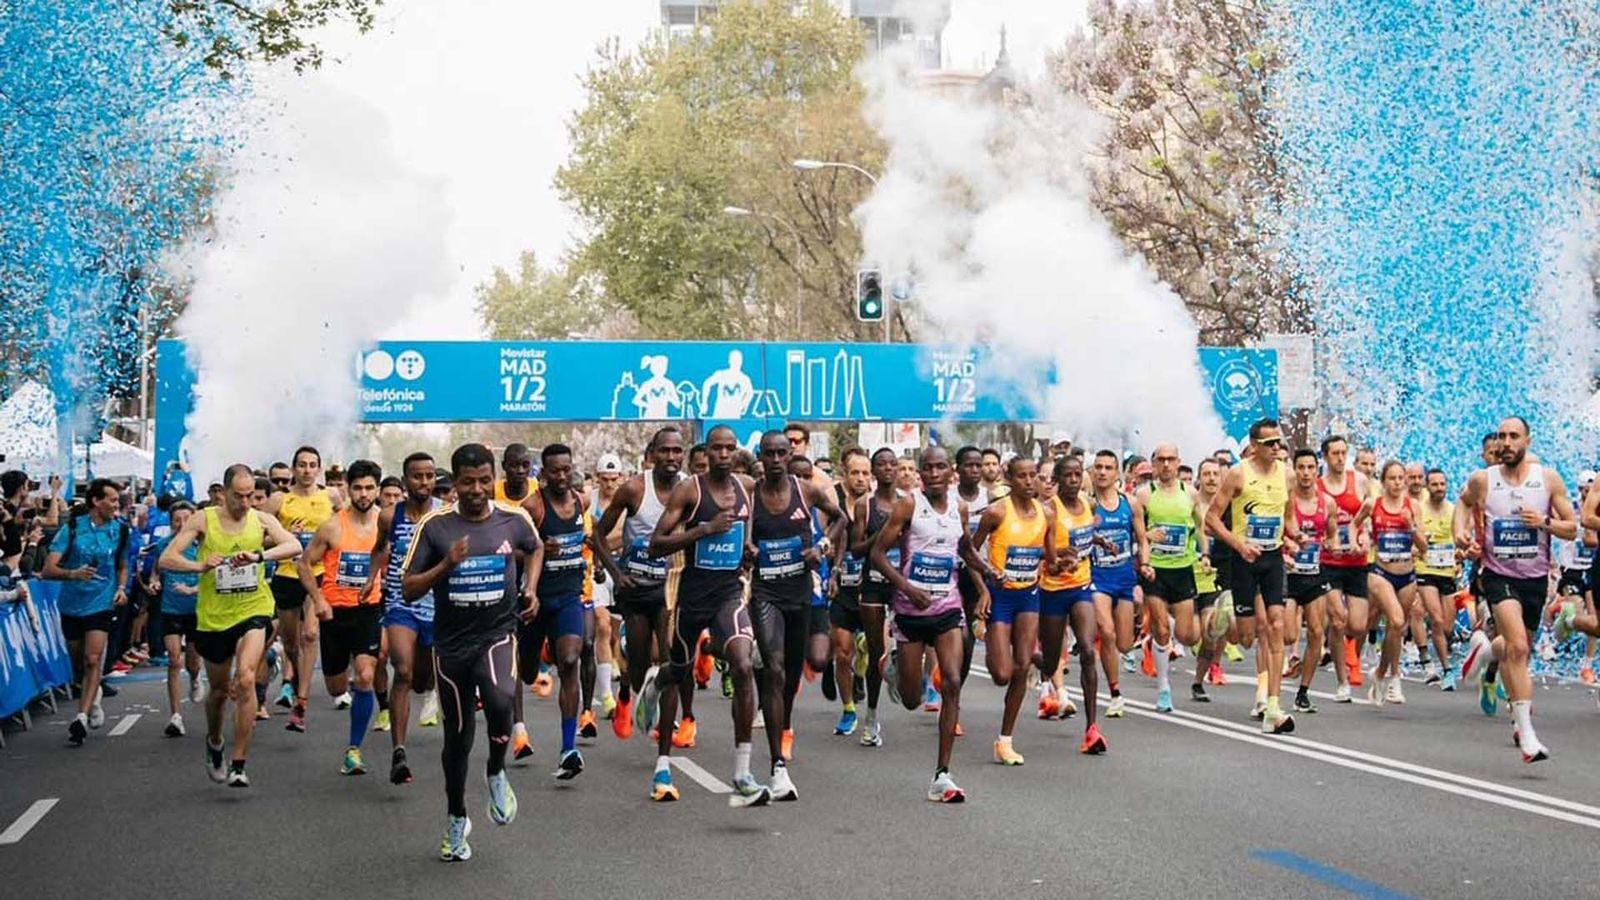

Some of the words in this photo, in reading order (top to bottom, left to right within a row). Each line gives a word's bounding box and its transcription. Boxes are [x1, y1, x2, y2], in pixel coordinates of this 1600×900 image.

[501, 347, 546, 358] Movistar
[500, 359, 546, 375] MAD
[933, 361, 976, 377] MAD
[500, 376, 546, 401] 1/2
[933, 378, 976, 402] 1/2
[500, 401, 546, 412] MARATÓN
[1500, 532, 1530, 541] PACER
[707, 542, 736, 553] PACE
[769, 551, 791, 562] MIKE
